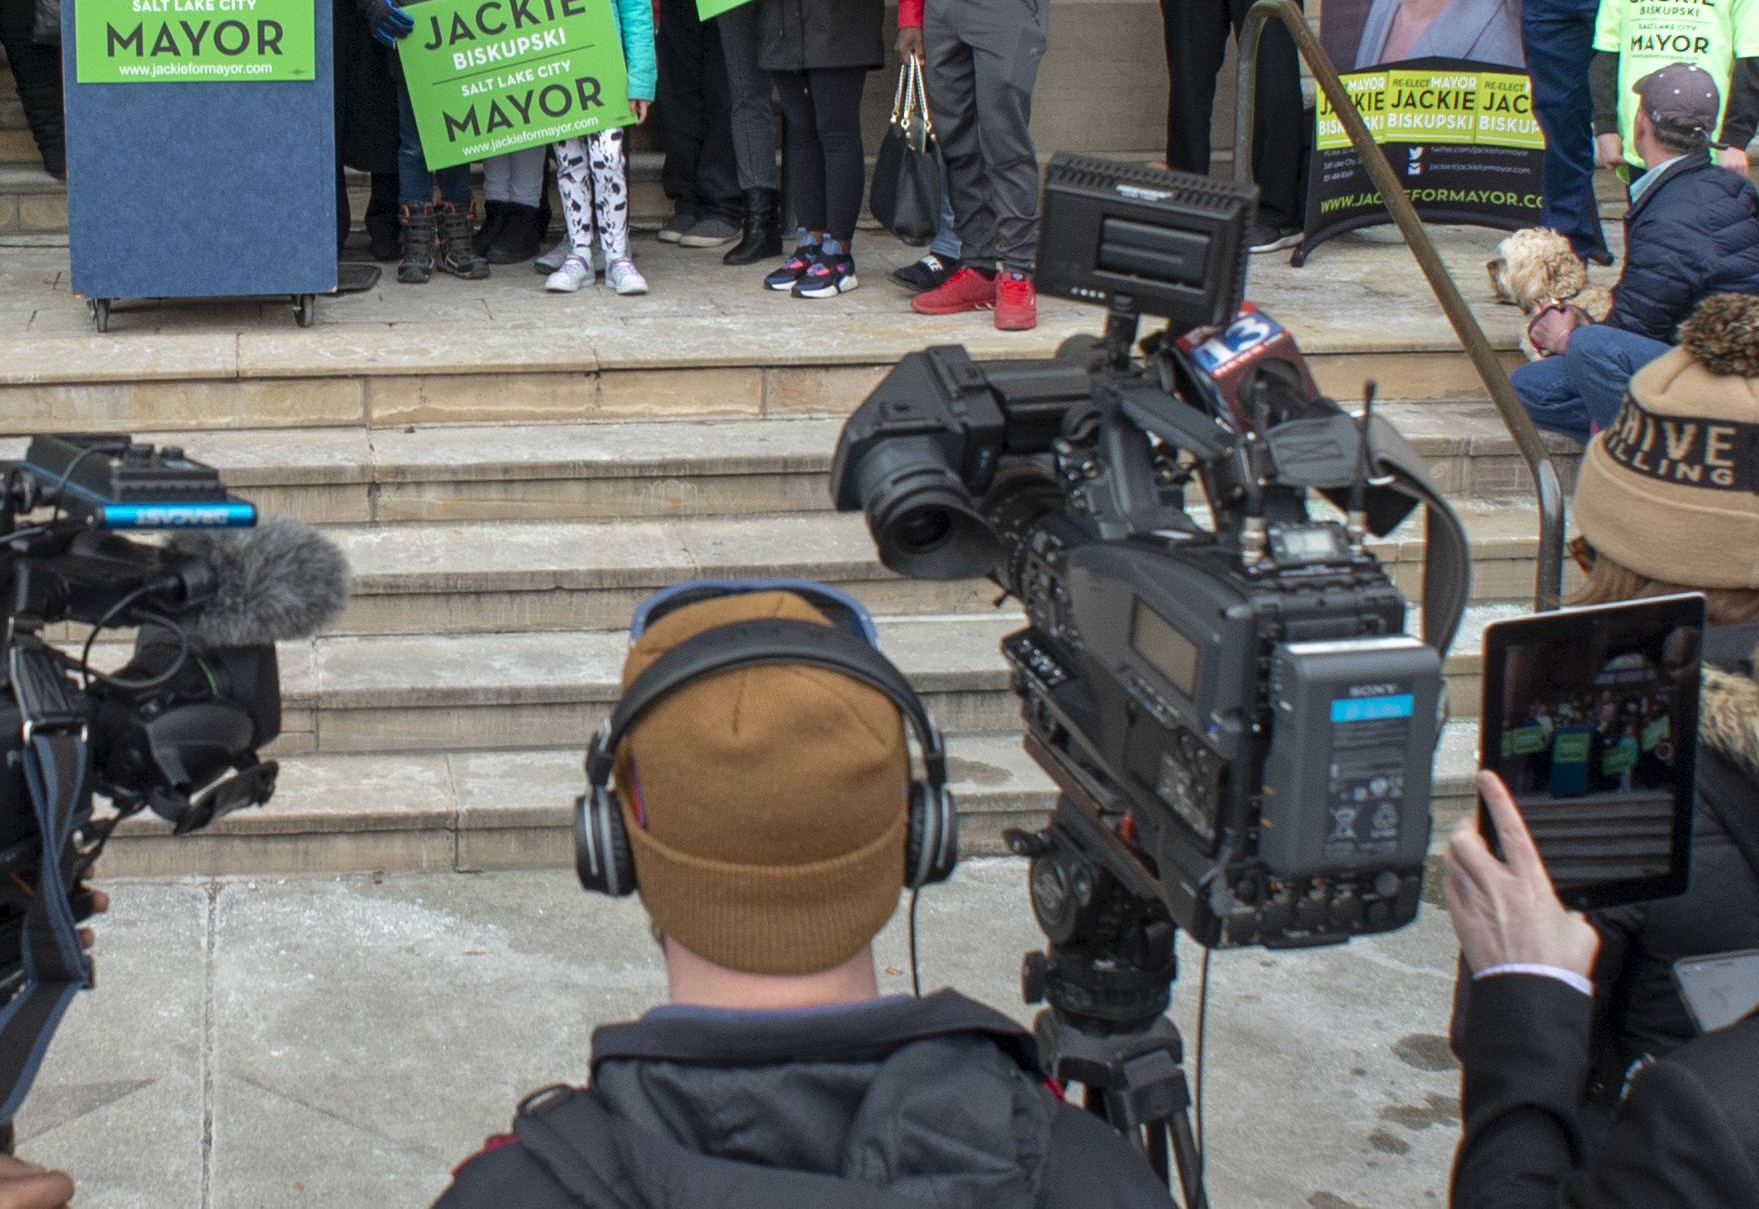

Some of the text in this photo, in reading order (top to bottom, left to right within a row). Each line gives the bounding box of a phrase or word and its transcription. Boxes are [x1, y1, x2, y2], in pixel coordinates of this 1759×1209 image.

[132, 0, 170, 12] SALT
[1640, 6, 1700, 17] BISKUPSKI
[106, 20, 283, 57] MAYOR
[1630, 34, 1709, 54] MAYOR
[453, 28, 567, 71] BISKUPSKI
[119, 63, 272, 77] www.jackieformayor.com
[461, 60, 571, 97] SALT LAKE CITY
[1347, 77, 1385, 91] MAYOR
[1392, 76, 1476, 90] RE-ELECT MAYOR
[442, 76, 605, 142] MAYOR
[1320, 92, 1384, 116] JKIE
[1391, 91, 1475, 111] JACKIE
[1483, 94, 1530, 114] JAC
[1387, 113, 1473, 130] BISKUPSKI
[462, 116, 599, 156] www.jackieformayor.com
[1201, 318, 1271, 366] 13
